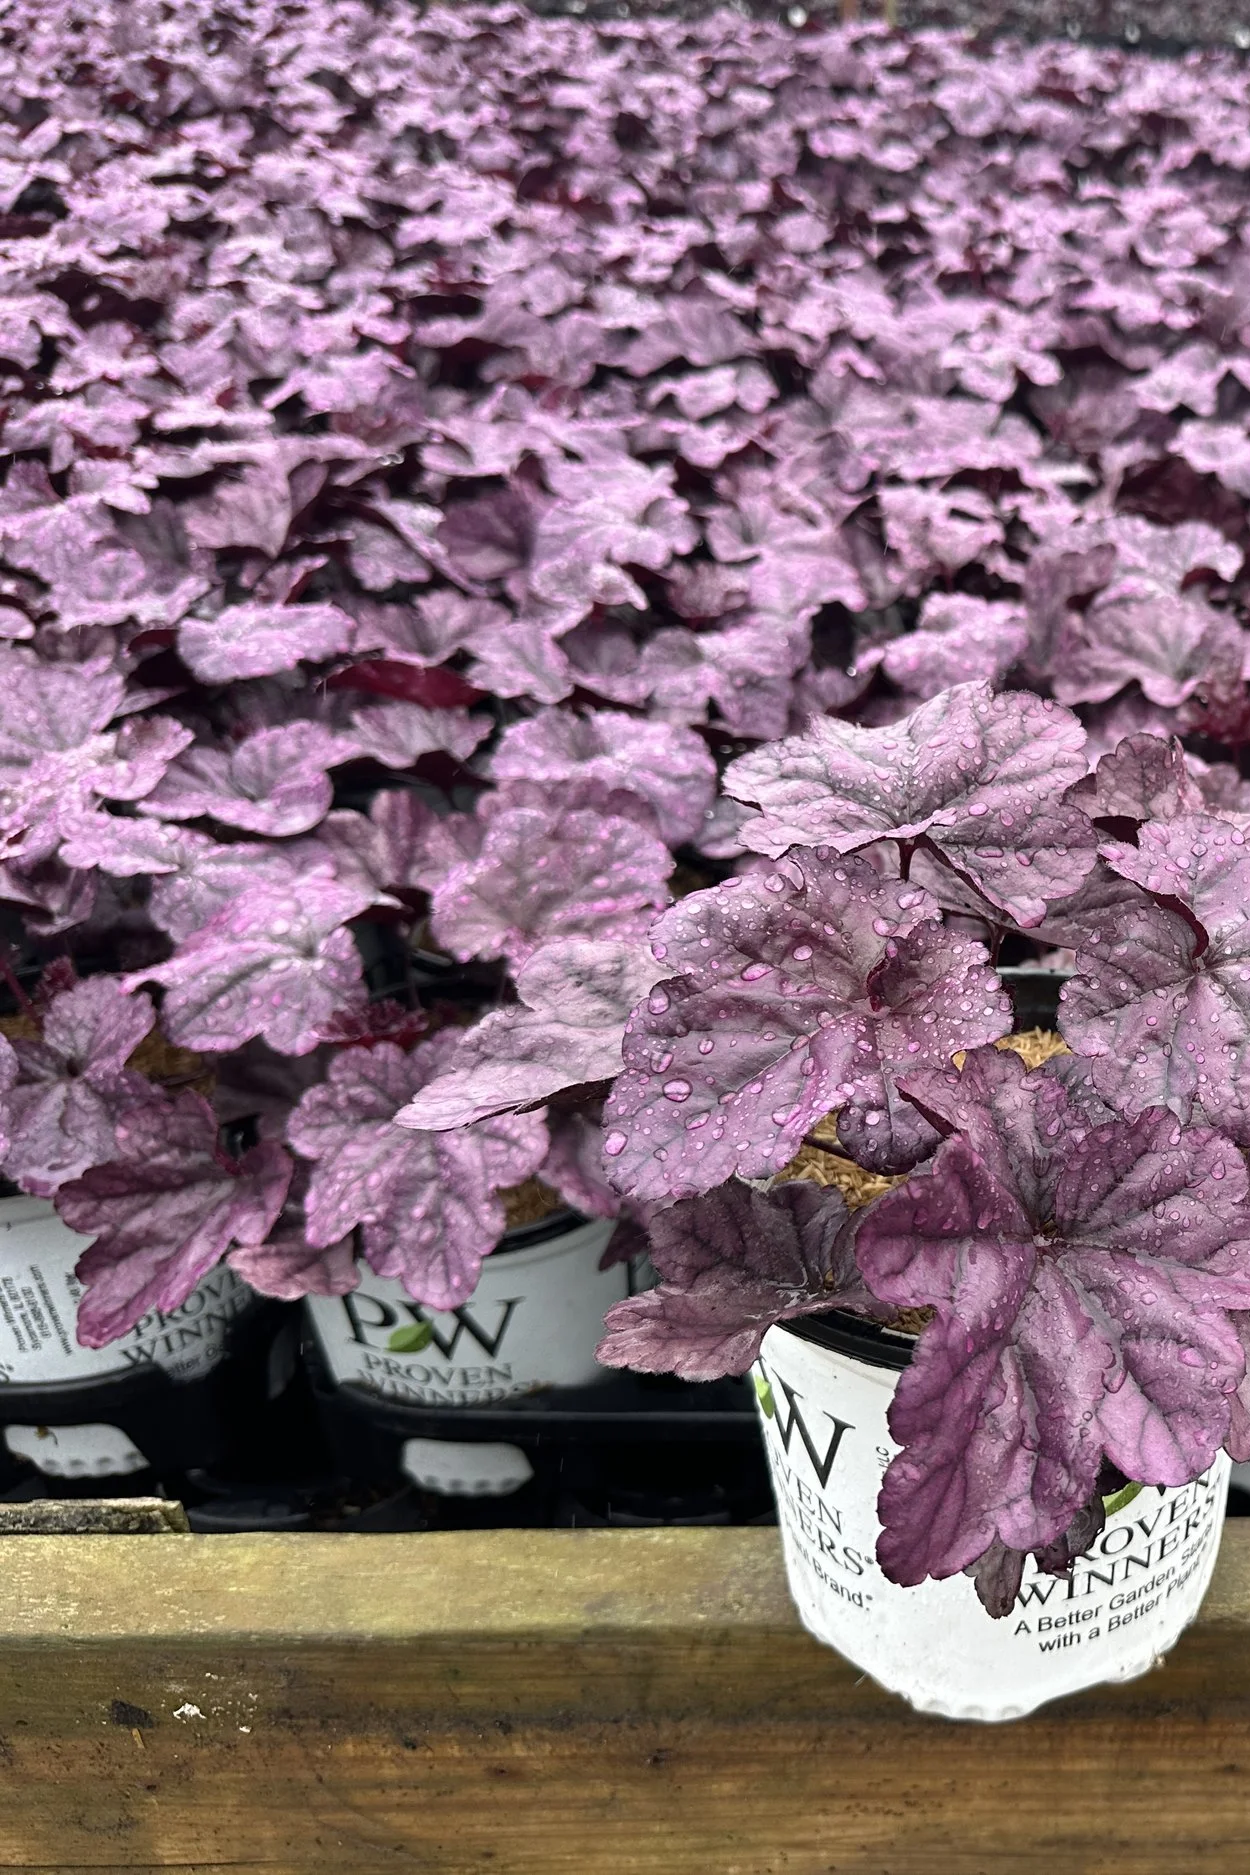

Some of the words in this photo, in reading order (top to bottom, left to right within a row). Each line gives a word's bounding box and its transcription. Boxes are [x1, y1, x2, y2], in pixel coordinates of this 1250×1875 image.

[341, 1291, 527, 1361] PW
[363, 1351, 513, 1387] PROVEN
[753, 1355, 857, 1490] W
[1013, 1619, 1033, 1637] A
[1037, 1603, 1104, 1633] Better
[1108, 1565, 1176, 1611] Garden
[1038, 1631, 1082, 1653] with
[1087, 1624, 1101, 1641] a
[1107, 1592, 1163, 1633] Better
